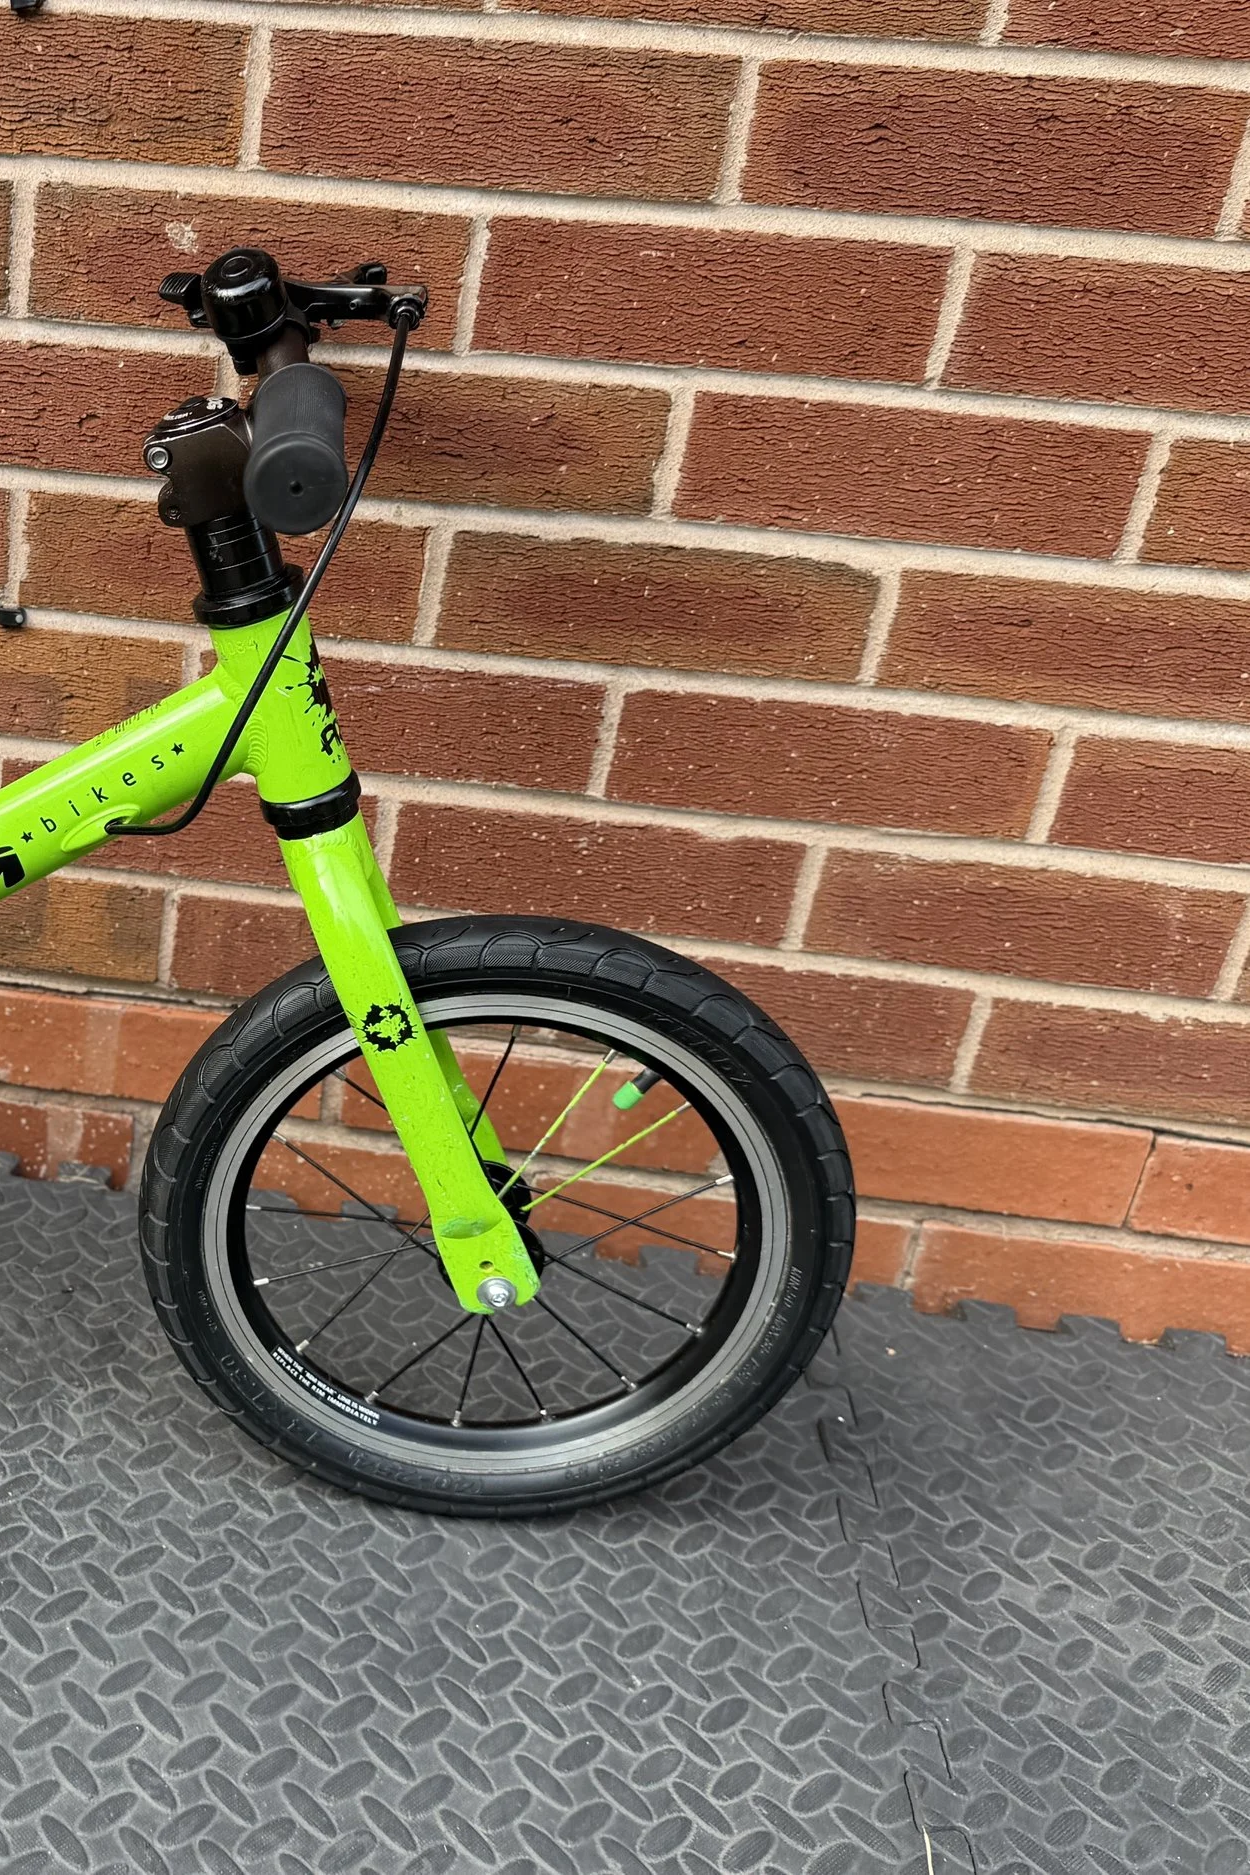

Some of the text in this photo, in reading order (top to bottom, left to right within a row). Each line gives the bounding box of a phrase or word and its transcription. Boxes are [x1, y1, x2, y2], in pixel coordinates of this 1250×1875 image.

[40, 754, 165, 833] bikes
[272, 1352, 378, 1426] REPLACE THE RIM IMMEDIATELY
[277, 1346, 295, 1363] WHEN
[293, 1360, 304, 1372] THE
[358, 1405, 380, 1420] WORN
